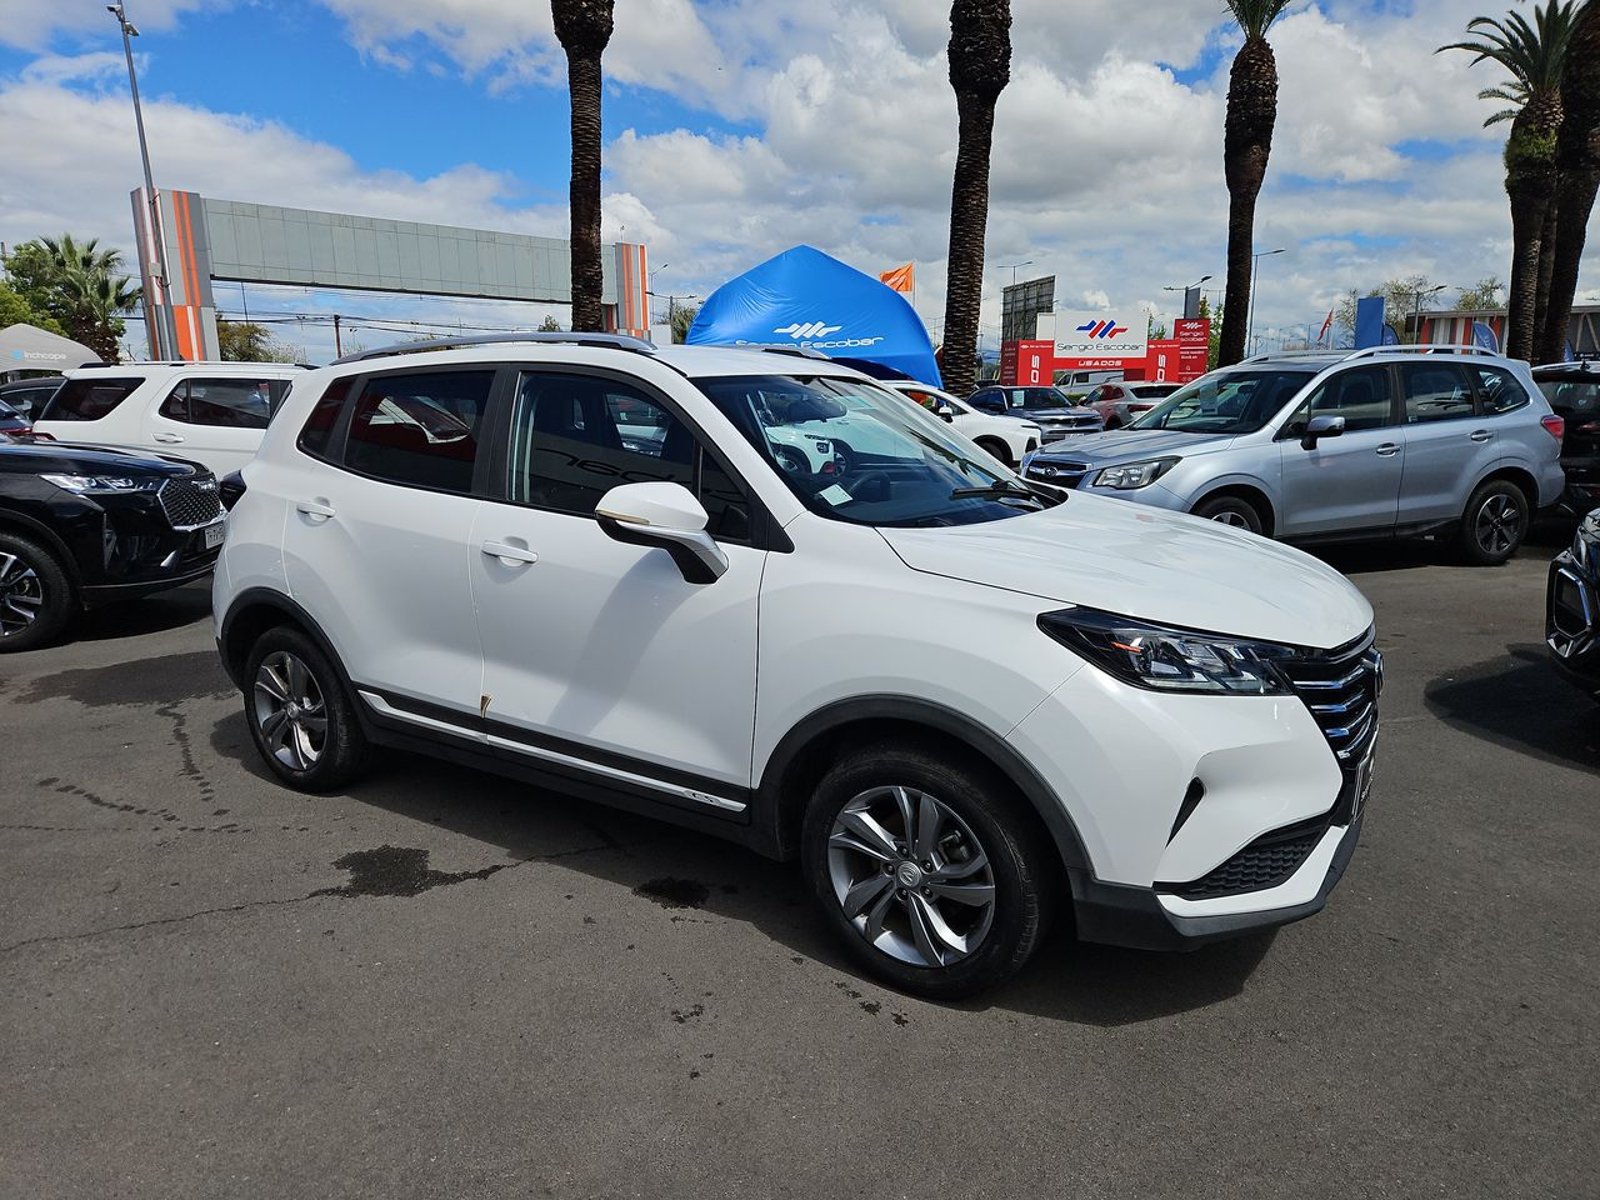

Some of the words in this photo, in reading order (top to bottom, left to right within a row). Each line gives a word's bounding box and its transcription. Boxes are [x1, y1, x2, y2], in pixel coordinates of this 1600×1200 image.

[800, 336, 884, 349] Escobar
[1056, 343, 1094, 352] Sergio
[1095, 343, 1144, 351] Escobar
